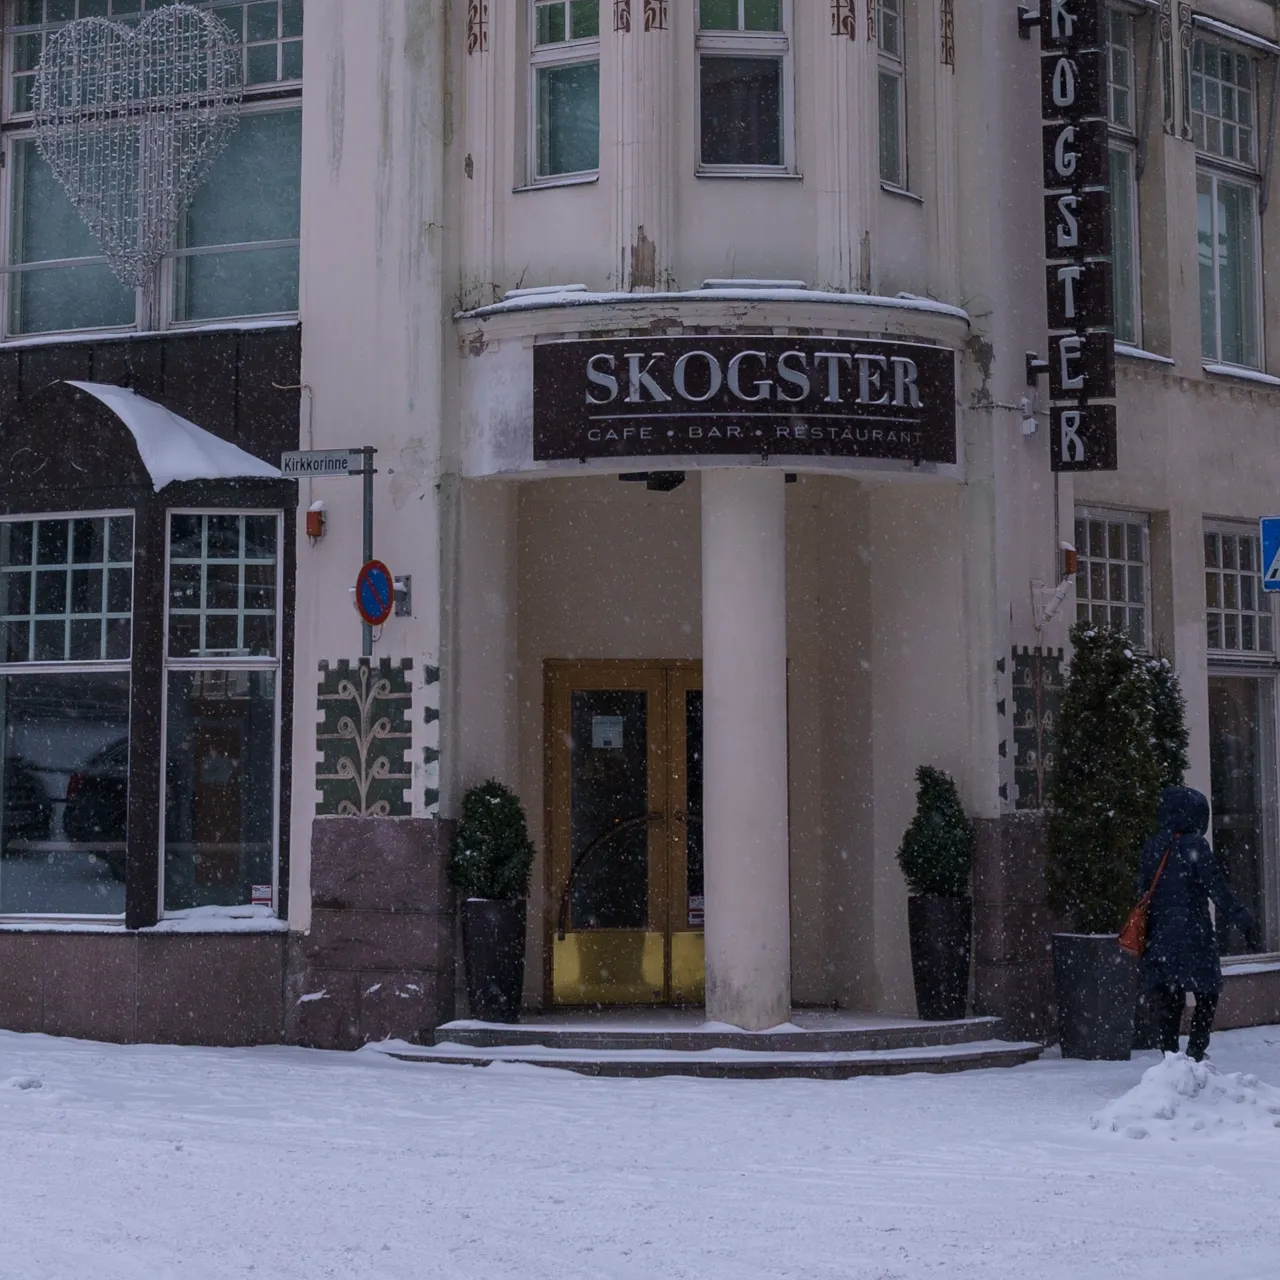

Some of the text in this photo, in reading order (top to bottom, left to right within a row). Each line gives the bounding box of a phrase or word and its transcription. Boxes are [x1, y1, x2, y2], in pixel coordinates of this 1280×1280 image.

[585, 349, 924, 409] SKOGSTER
[587, 426, 922, 444] CAFE BAR RESTAURANT
[284, 456, 349, 472] Kirkkorinne
